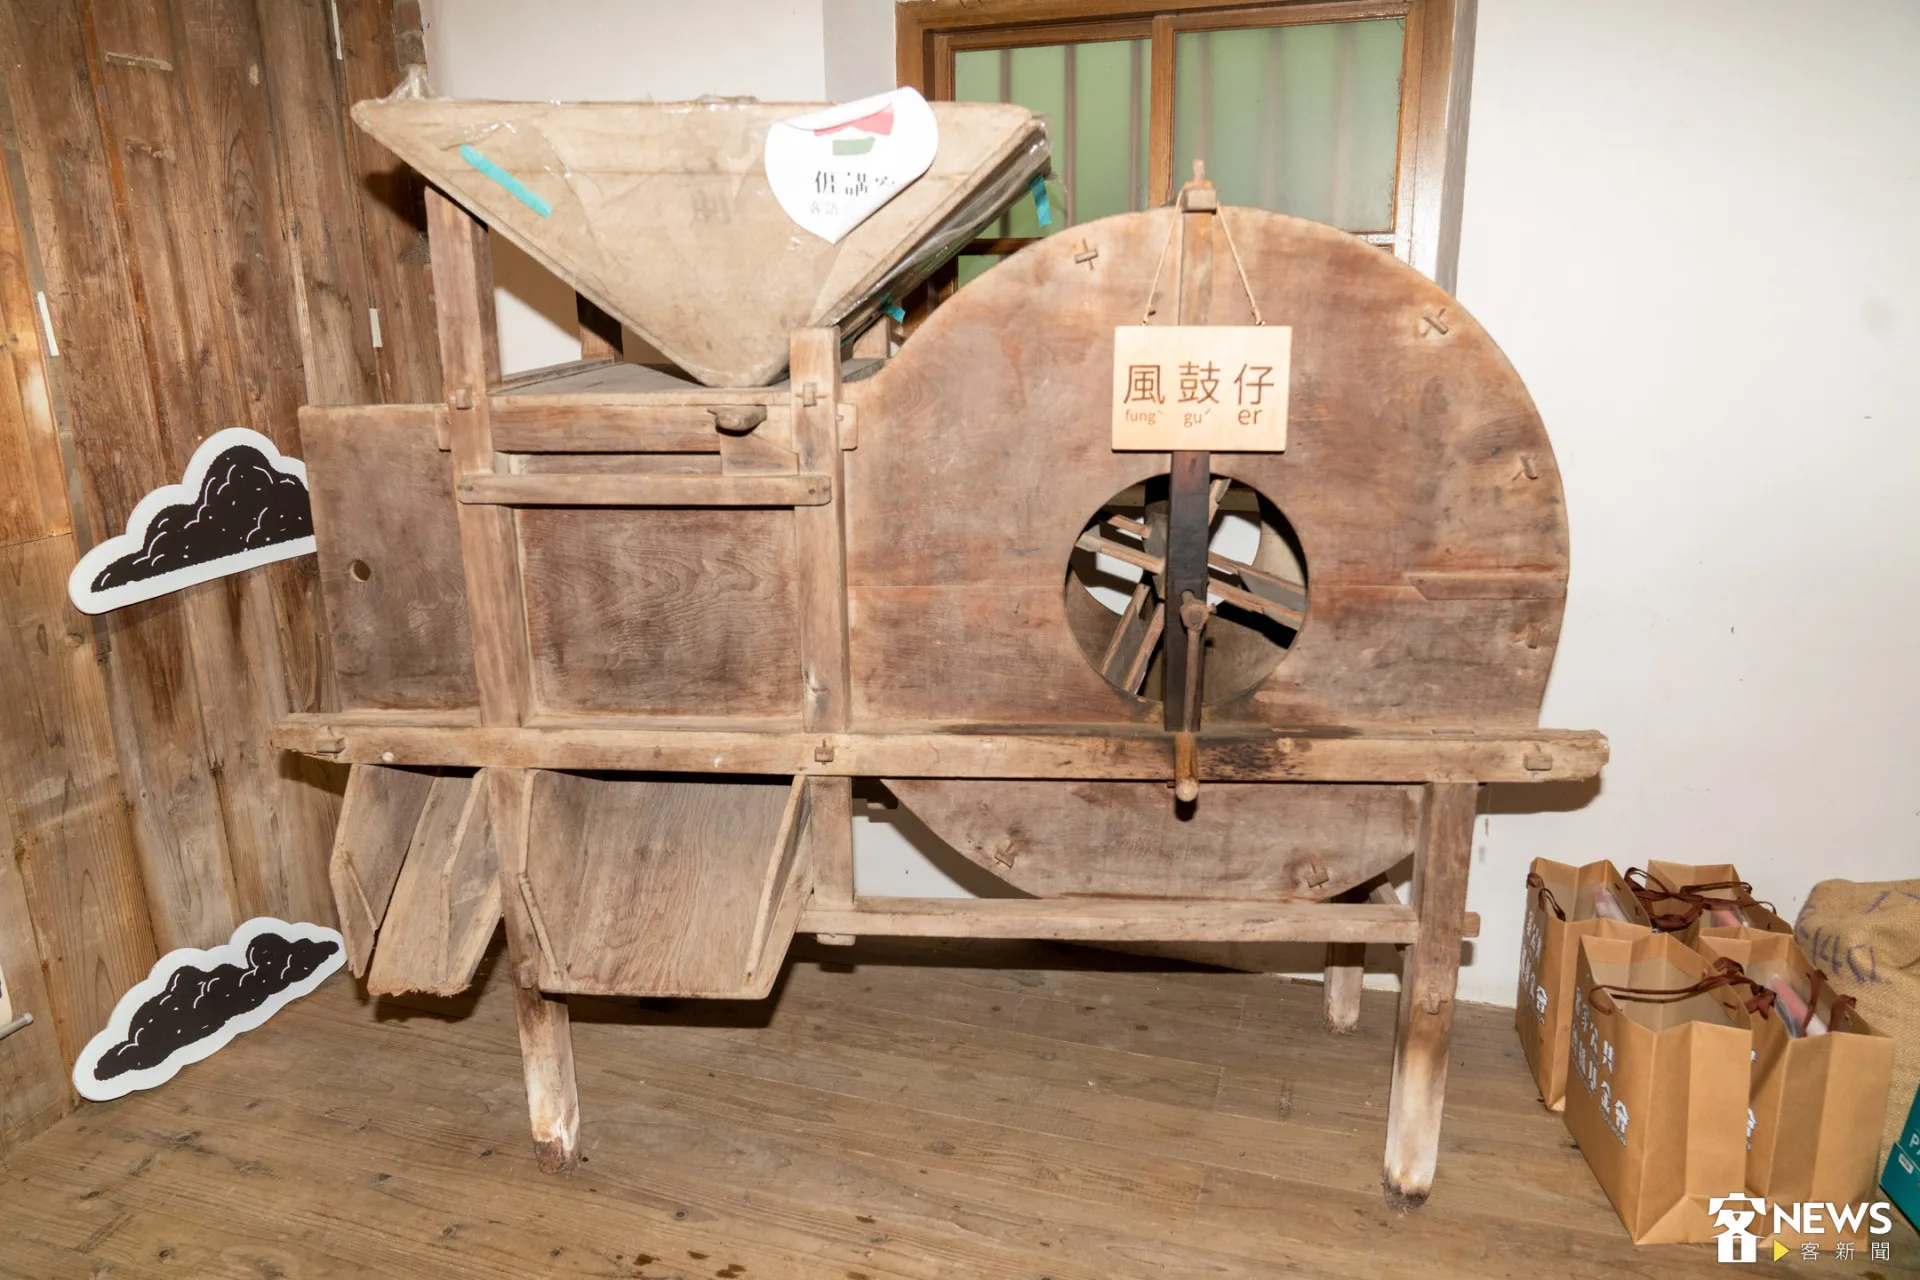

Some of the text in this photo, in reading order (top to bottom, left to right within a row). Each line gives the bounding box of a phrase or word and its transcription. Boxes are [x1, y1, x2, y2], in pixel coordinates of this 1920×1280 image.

[1123, 361, 1274, 406] 風鼓仔
[1238, 409, 1263, 425] er
